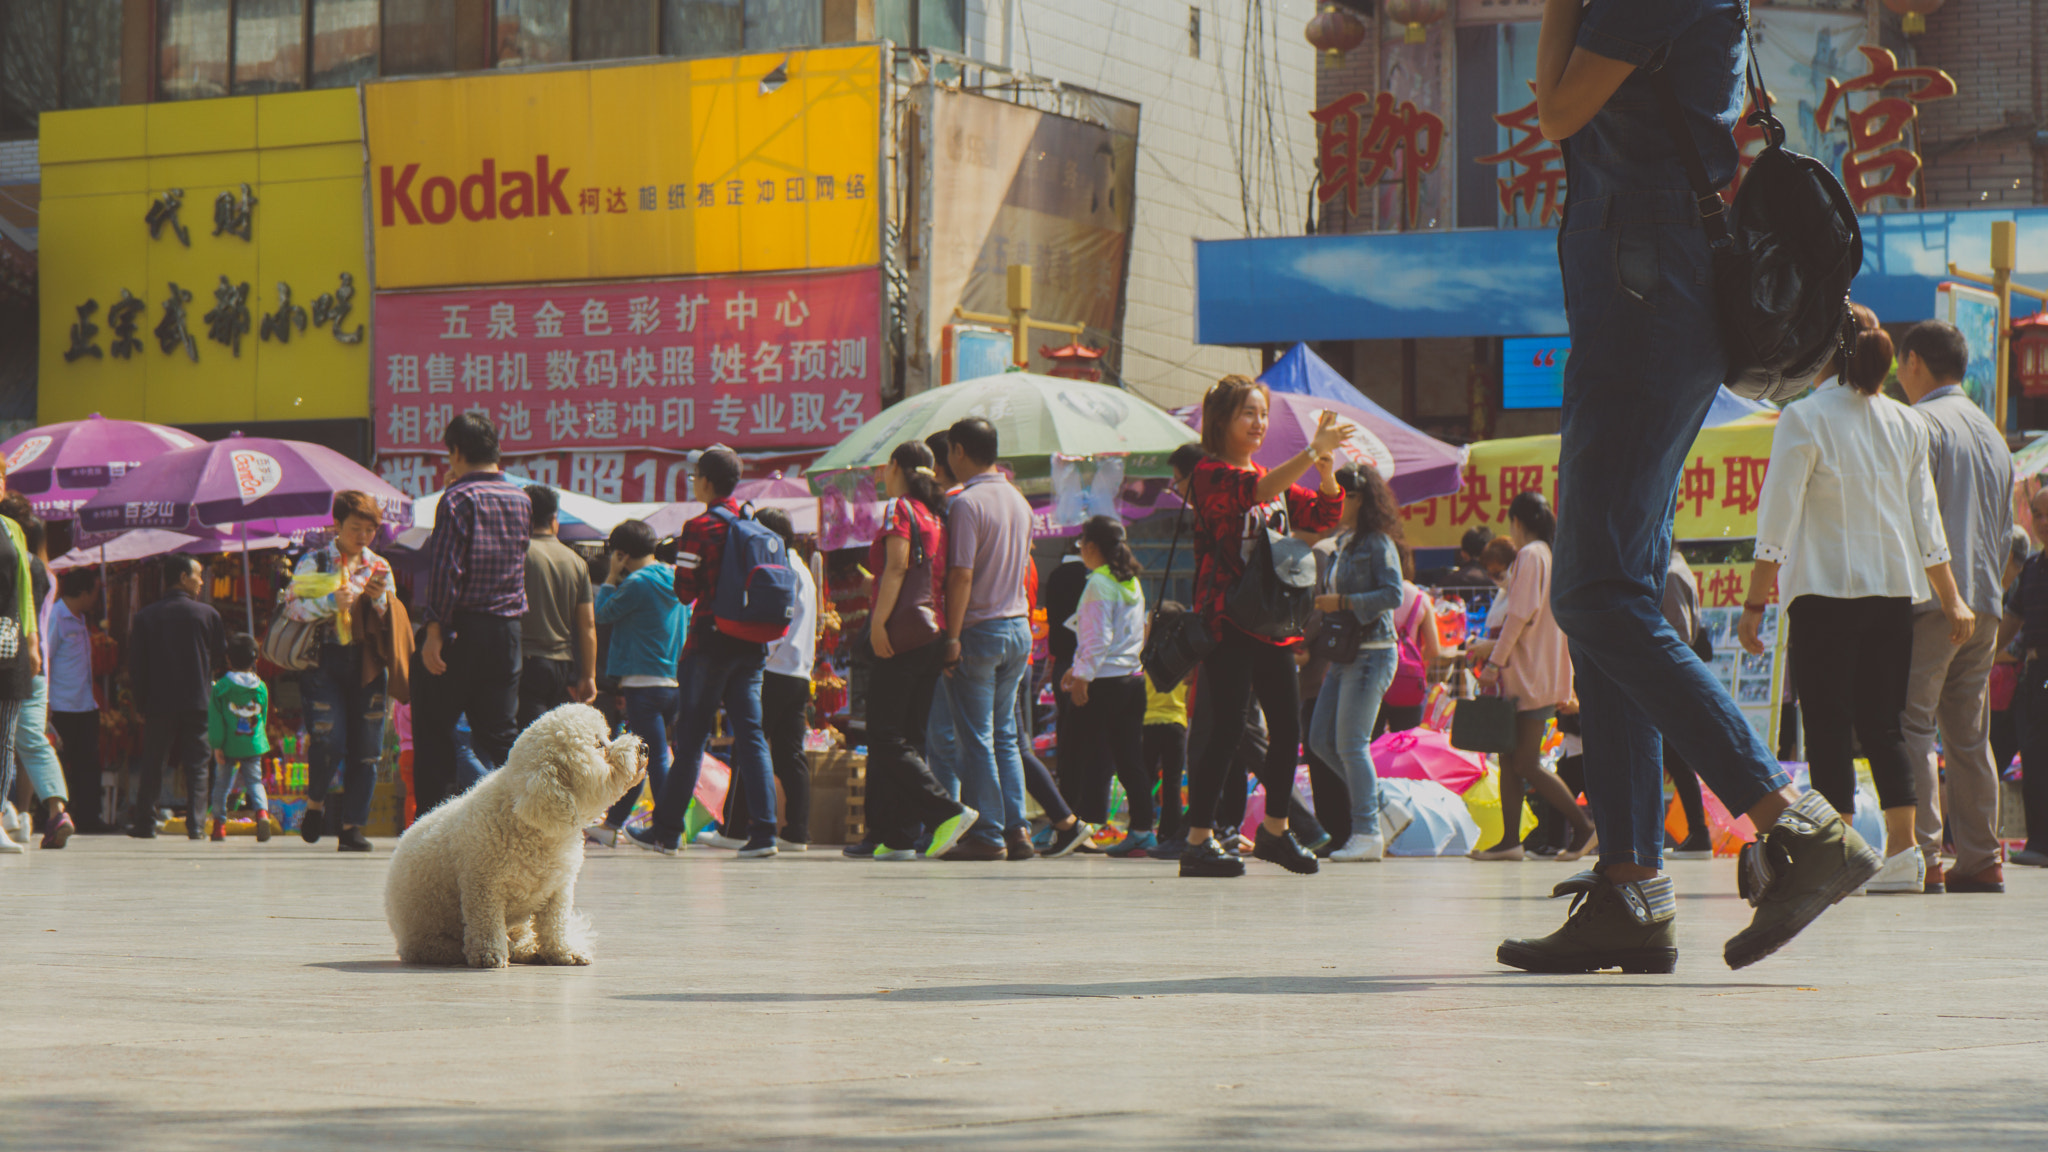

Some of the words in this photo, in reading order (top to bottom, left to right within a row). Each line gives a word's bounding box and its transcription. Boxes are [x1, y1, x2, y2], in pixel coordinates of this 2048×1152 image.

[379, 155, 573, 227] Kodak
[579, 186, 629, 215] 柯达
[638, 173, 867, 212] 相纸指定冲印网络
[440, 290, 810, 340] 五泉金色彩扩中心
[387, 351, 532, 394] 租售相机
[546, 345, 697, 390] 数码快照
[710, 336, 868, 386] 姓名预测
[387, 401, 533, 445] 相机池
[546, 396, 697, 441] 快速冲印
[710, 389, 867, 437] 专业取名
